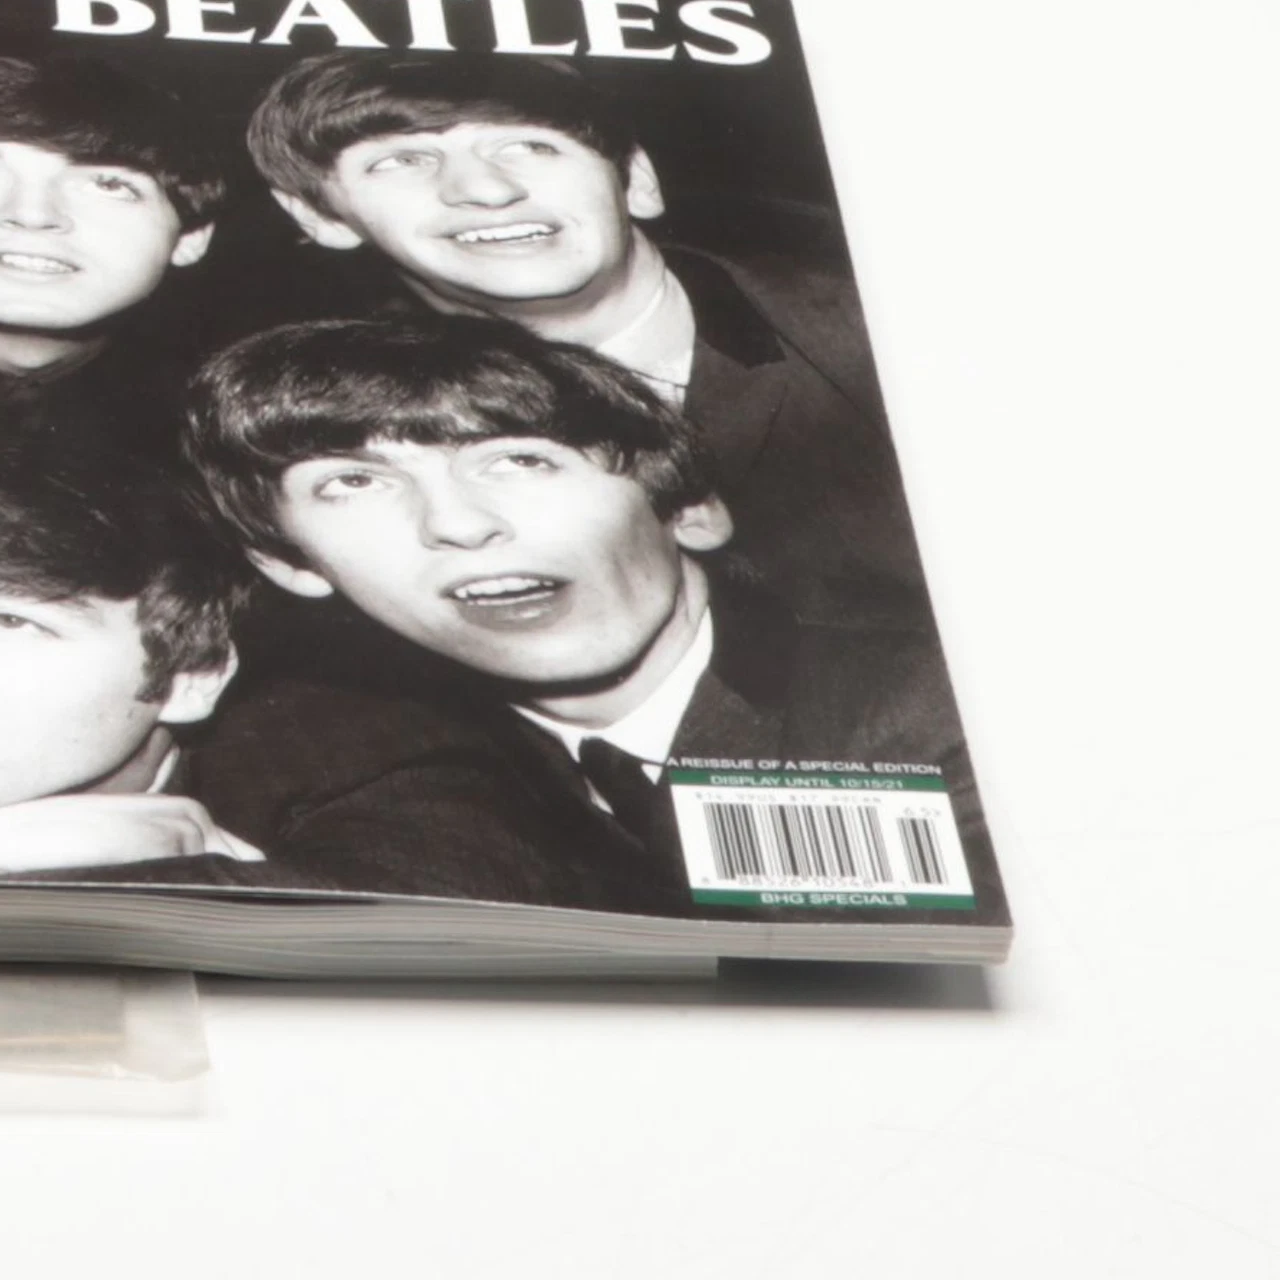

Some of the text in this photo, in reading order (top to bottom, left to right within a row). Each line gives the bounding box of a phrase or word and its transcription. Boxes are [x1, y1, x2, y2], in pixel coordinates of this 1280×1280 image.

[666, 757, 942, 775] A REISSUE OF A SPECIAL EDITION
[710, 774, 782, 787] DISPLAY
[785, 776, 836, 788] UNTIL
[759, 892, 908, 906] BHG SPECIALS
